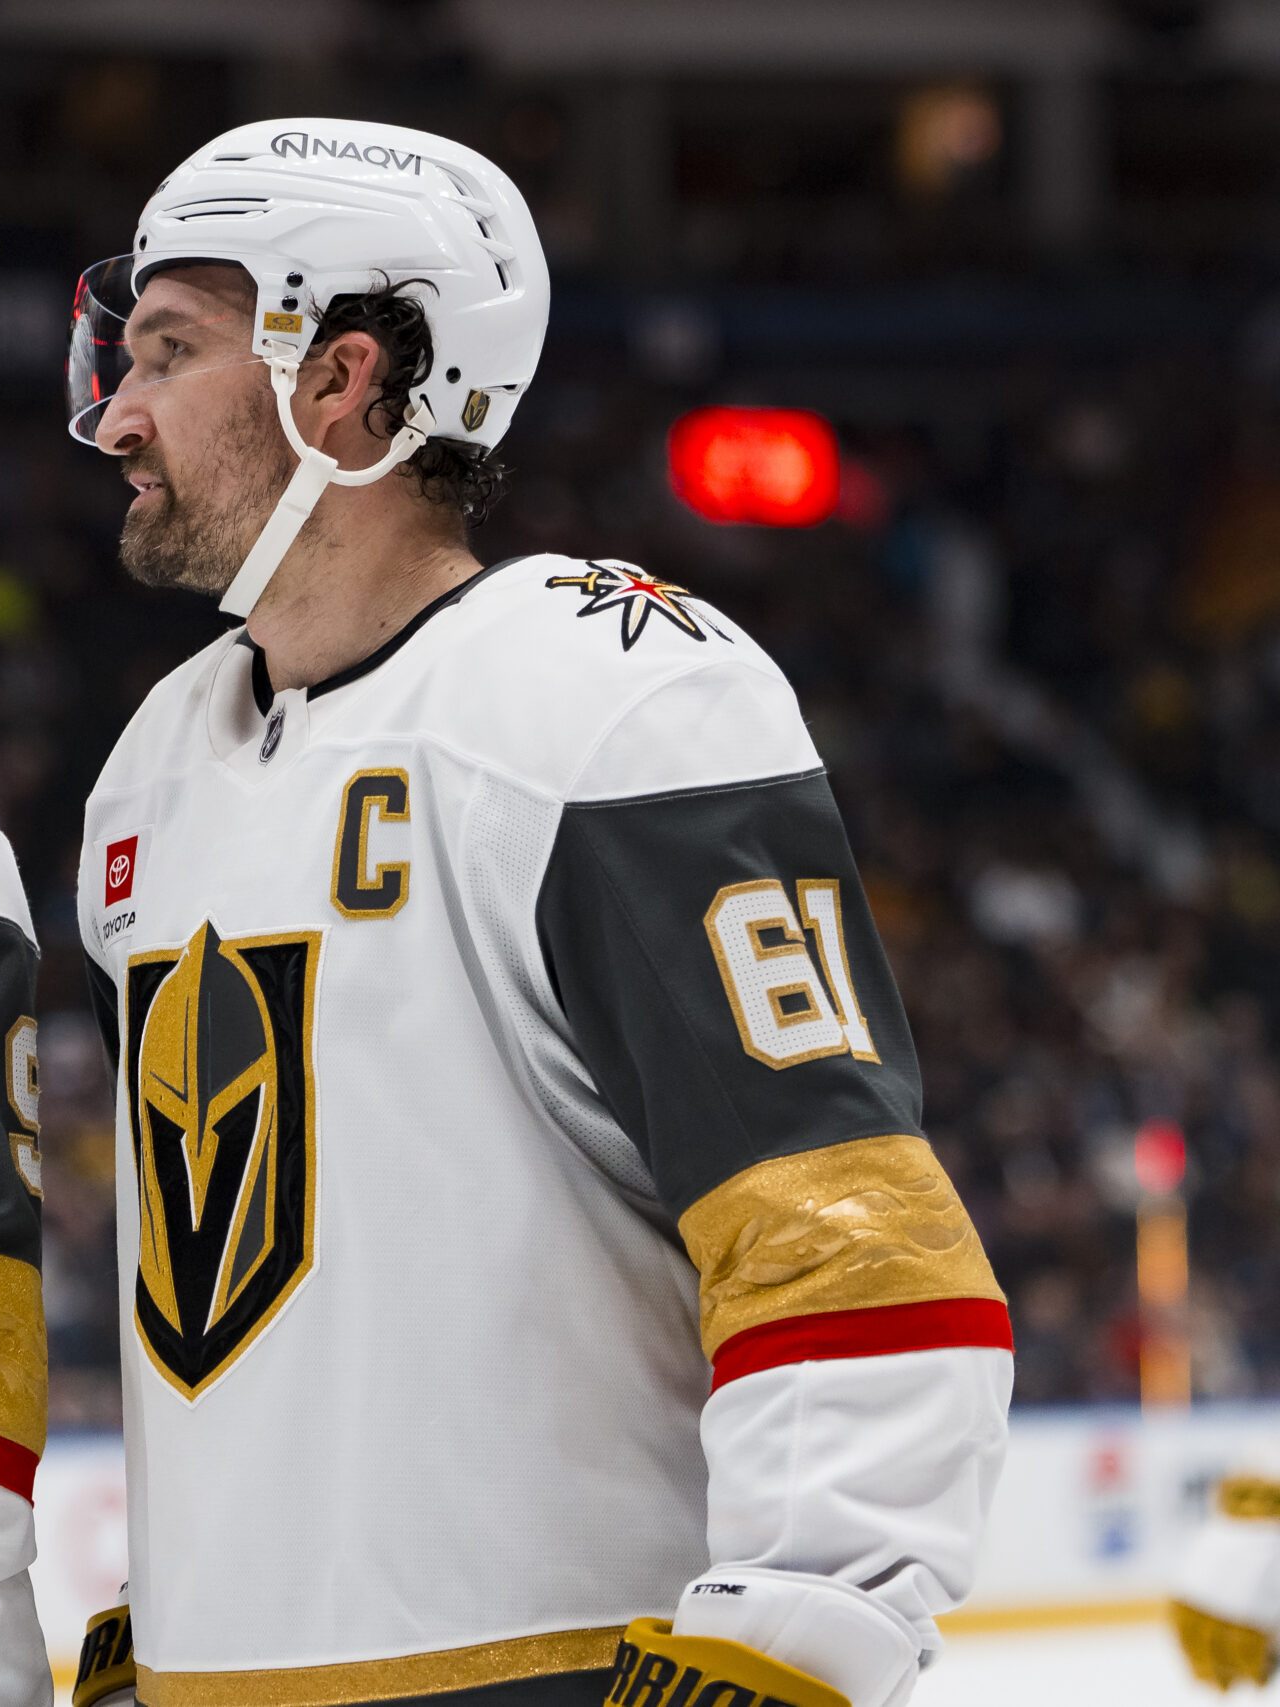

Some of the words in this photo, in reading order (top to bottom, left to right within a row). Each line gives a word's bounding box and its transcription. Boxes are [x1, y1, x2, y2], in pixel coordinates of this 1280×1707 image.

[330, 767, 411, 920] C
[102, 911, 136, 941] TOYOTA
[702, 878, 882, 1072] 61
[691, 1583, 748, 1596] STONE
